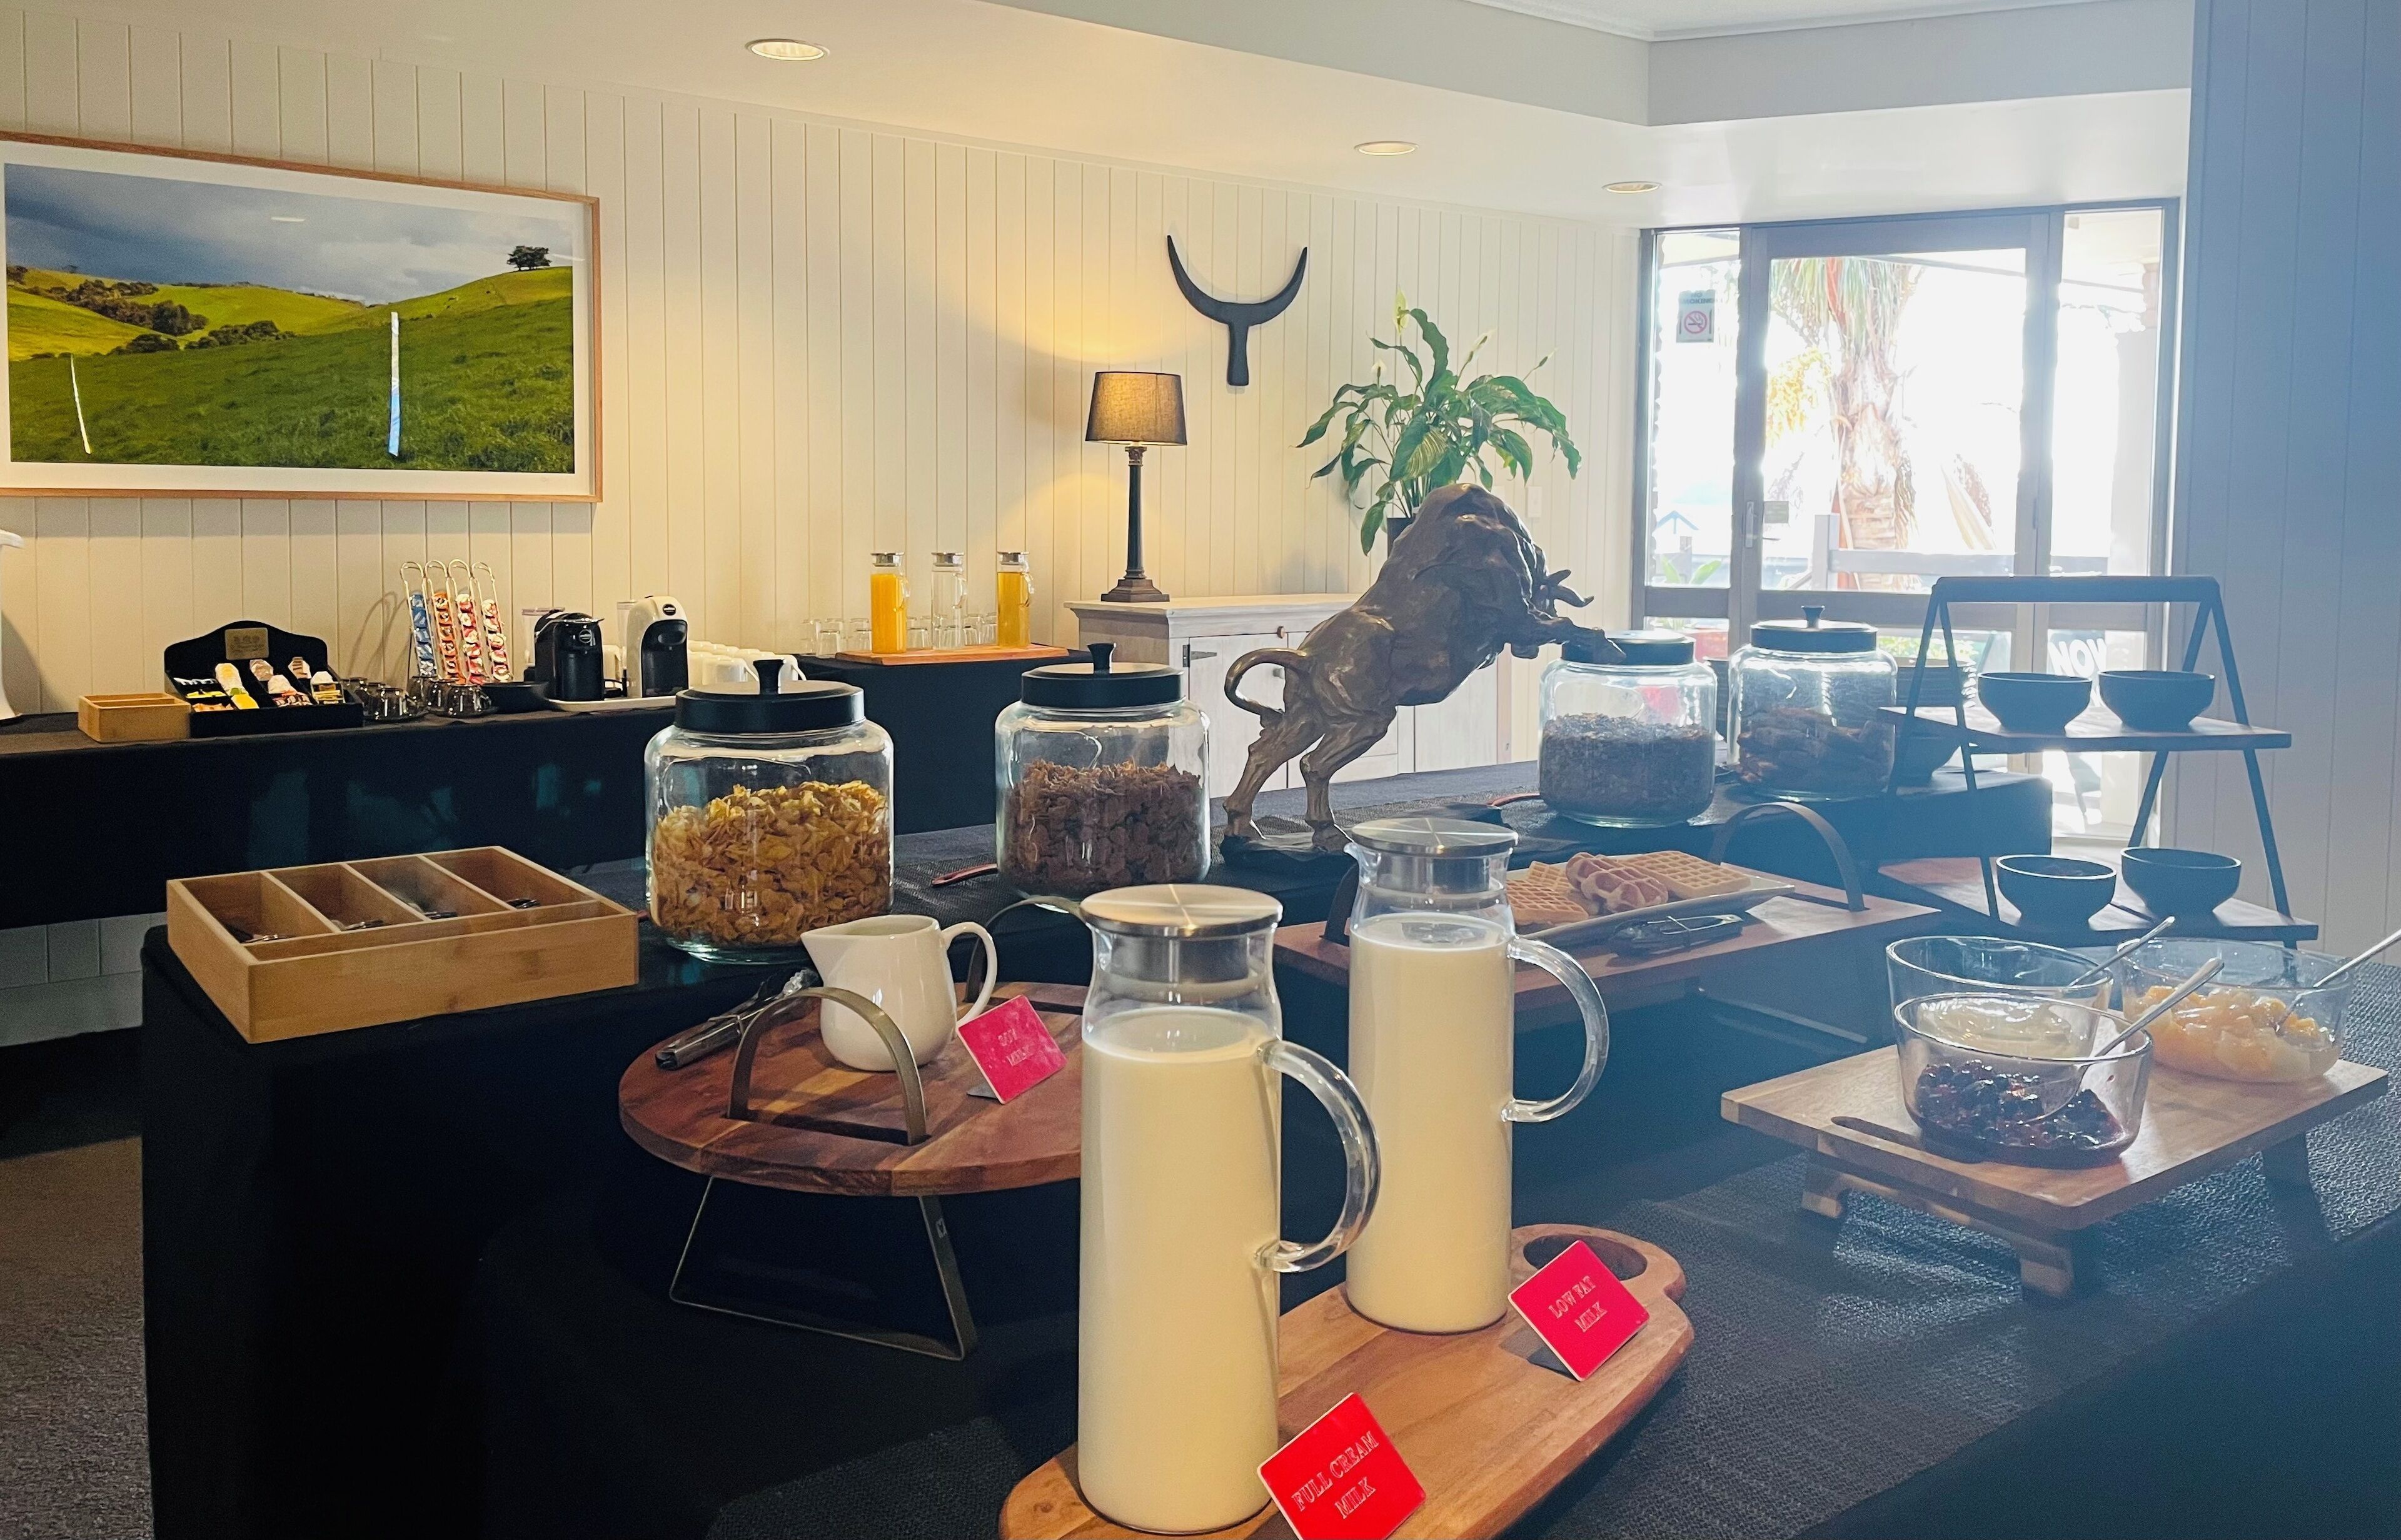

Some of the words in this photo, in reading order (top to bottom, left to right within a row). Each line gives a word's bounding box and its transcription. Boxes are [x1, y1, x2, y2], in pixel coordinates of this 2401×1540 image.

[1548, 1291, 1577, 1319] LOW
[1572, 1275, 1596, 1299] FAT
[1574, 1301, 1608, 1333] MILK
[1291, 1472, 1333, 1512] FULL
[1329, 1431, 1379, 1479] CREAM
[1334, 1476, 1377, 1519] MILK
